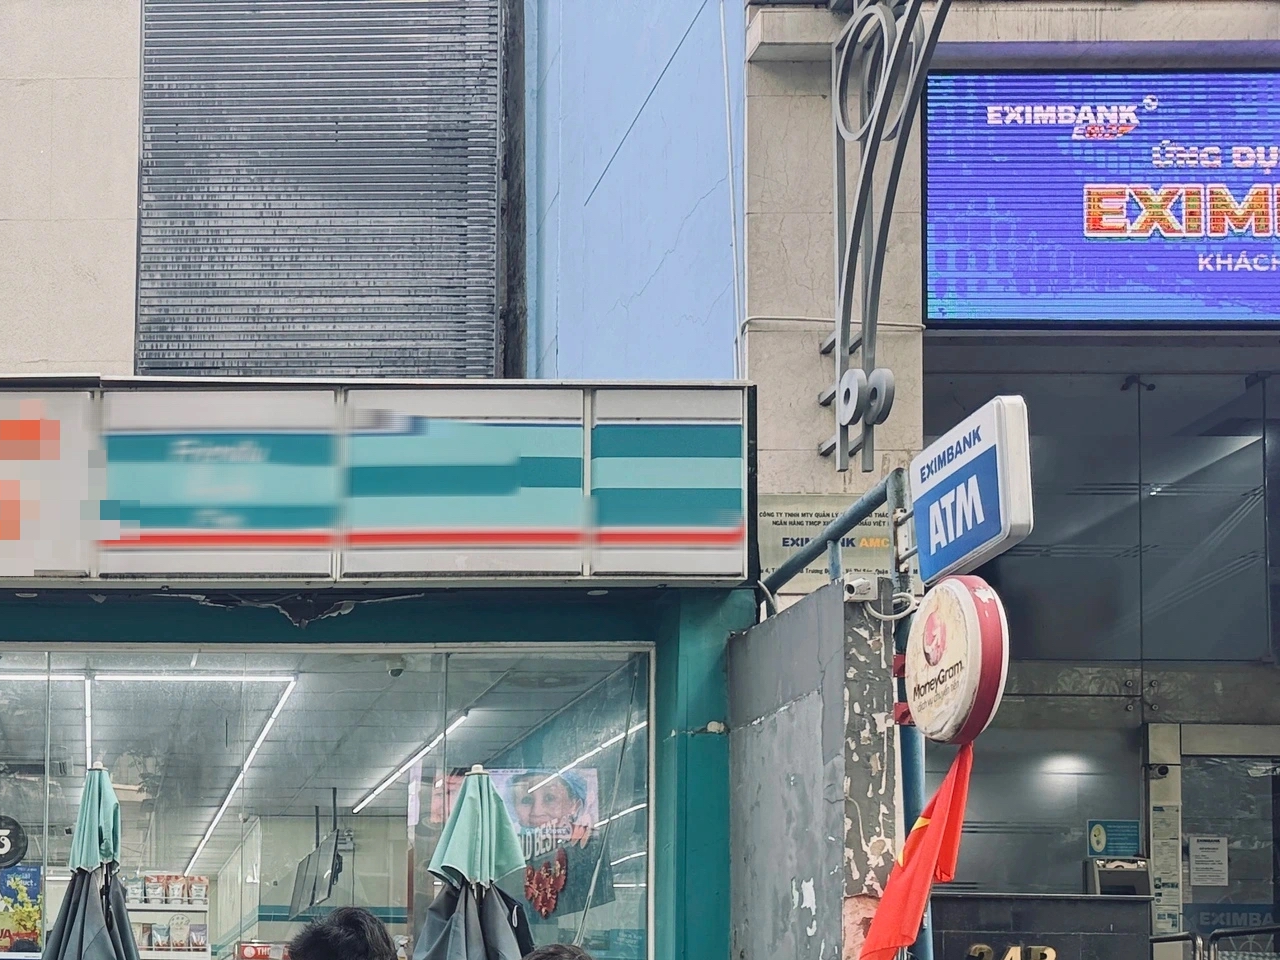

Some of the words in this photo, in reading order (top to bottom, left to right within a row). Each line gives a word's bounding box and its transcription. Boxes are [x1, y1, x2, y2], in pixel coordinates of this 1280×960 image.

[986, 104, 1140, 125] EXIMBANK
[1082, 183, 1280, 240] EXIM
[920, 424, 982, 484] EXIMBANK
[929, 473, 985, 556] ATM
[860, 538, 889, 548] AMC
[913, 659, 964, 702] MoneyGram
